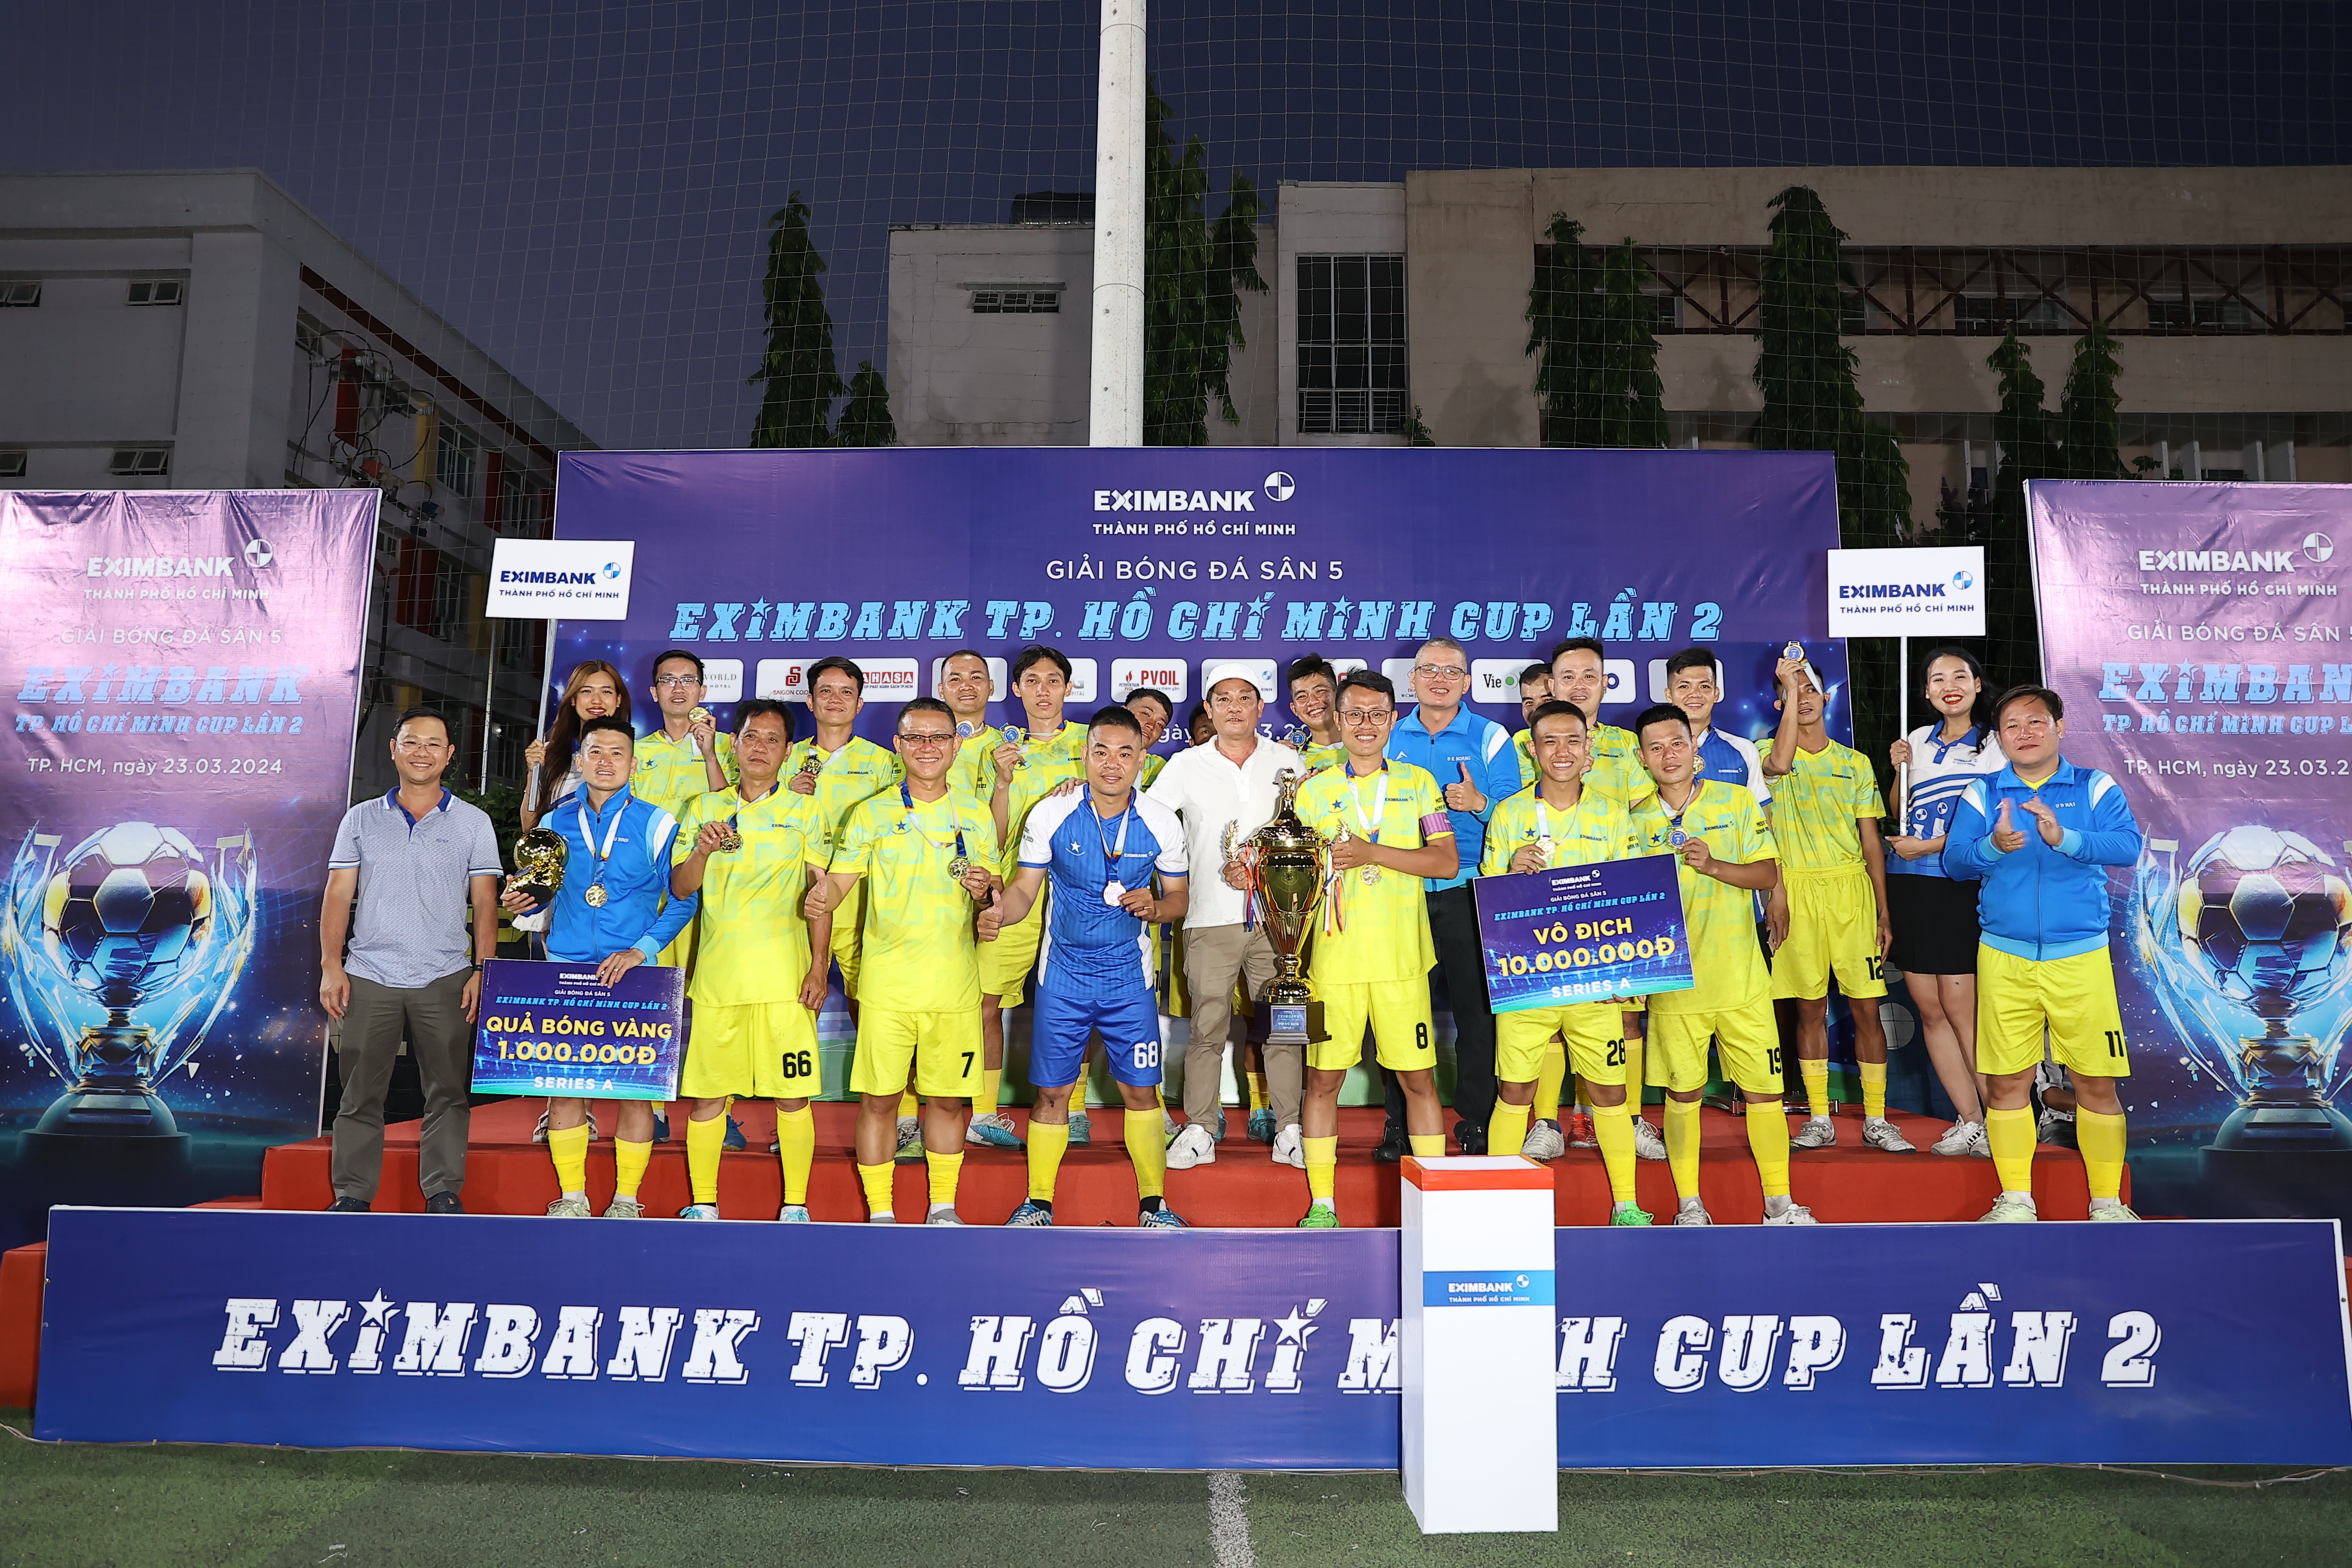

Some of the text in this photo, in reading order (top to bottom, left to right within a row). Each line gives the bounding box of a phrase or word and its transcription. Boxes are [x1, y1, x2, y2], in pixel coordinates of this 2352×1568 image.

[1093, 490, 1255, 512] EXIMBANK
[1093, 519, 1296, 535] THÀNH PHỐ HỒ CHÍ MINH
[87, 557, 236, 577] EXIMBANK
[1046, 553, 1343, 580] GIẢI BÓNG ĐÁ SÂN 5
[2138, 550, 2295, 572] EXIMBANK
[500, 571, 596, 585] EXIMBANK
[2140, 580, 2337, 596] THÀNH PHỐ HỒ CHÍ MINH
[84, 585, 269, 600] THÀNH PHỐ HỒ CHÍ MINH
[536, 589, 555, 597] PHỐ
[559, 589, 572, 597] HỒ
[1840, 584, 1946, 598] EXIMBANK
[985, 601, 1062, 640] TP.
[1077, 586, 1157, 641] HỒ
[1450, 601, 1554, 642] CUP
[1566, 588, 1678, 641] LẦN
[1690, 602, 1724, 641] 2
[1840, 605, 1876, 613] THÀNH
[1881, 603, 1902, 612] PHỐ
[1906, 603, 1921, 612] HỒ
[61, 624, 282, 644] GIẢI BÓNG ĐÁ SÂN 5
[2127, 619, 2172, 640] GIẢI
[2181, 621, 2245, 641] BÓNG
[2253, 622, 2286, 641] ĐÁ
[2294, 623, 2340, 641] SÂN
[1141, 671, 1179, 685] PVOIL
[1483, 674, 1501, 688] Vie
[52, 709, 86, 733] HỒ
[195, 717, 238, 734] CUP
[241, 710, 287, 734] LẦN
[288, 717, 304, 734] 2
[2102, 714, 2135, 732] TP.
[2139, 708, 2171, 733] HỒ
[2289, 716, 2335, 735] CUP
[28, 758, 282, 776] TP. HCM, ngày 23.03.2024
[2124, 759, 2352, 778] TP. HCM, ngày 23.03.2
[1551, 875, 1591, 885] EXIMBANK
[1561, 901, 1573, 913] HỒ
[1620, 896, 1638, 905] CUP
[1639, 891, 1657, 903] LẦN
[1532, 916, 1633, 945] VÔ ĐỊCH
[1497, 937, 1675, 977] 10.000.000Đ
[1865, 956, 1884, 980] 12
[1551, 977, 1632, 998] SERIES A
[486, 1011, 672, 1038] QUẢ BÓNG VÀNG
[1416, 1022, 1428, 1049] 8
[498, 1040, 657, 1065] 1.000.000Đ
[1607, 1038, 1626, 1066] 28
[2105, 1030, 2124, 1057] 11
[783, 1050, 812, 1078] 66
[962, 1051, 975, 1078] 7
[1134, 1041, 1159, 1069] 68
[1767, 1047, 1782, 1075] 19
[534, 1076, 614, 1090] SERIES A
[1448, 1282, 1514, 1292] EXIMBANK
[786, 1311, 929, 1391] TP.
[957, 1287, 1105, 1394] HỒ
[1337, 1317, 1628, 1394] MH
[1654, 1314, 1847, 1393] CUP
[1870, 1282, 2078, 1390] LẦN
[2100, 1310, 2162, 1388] 2
